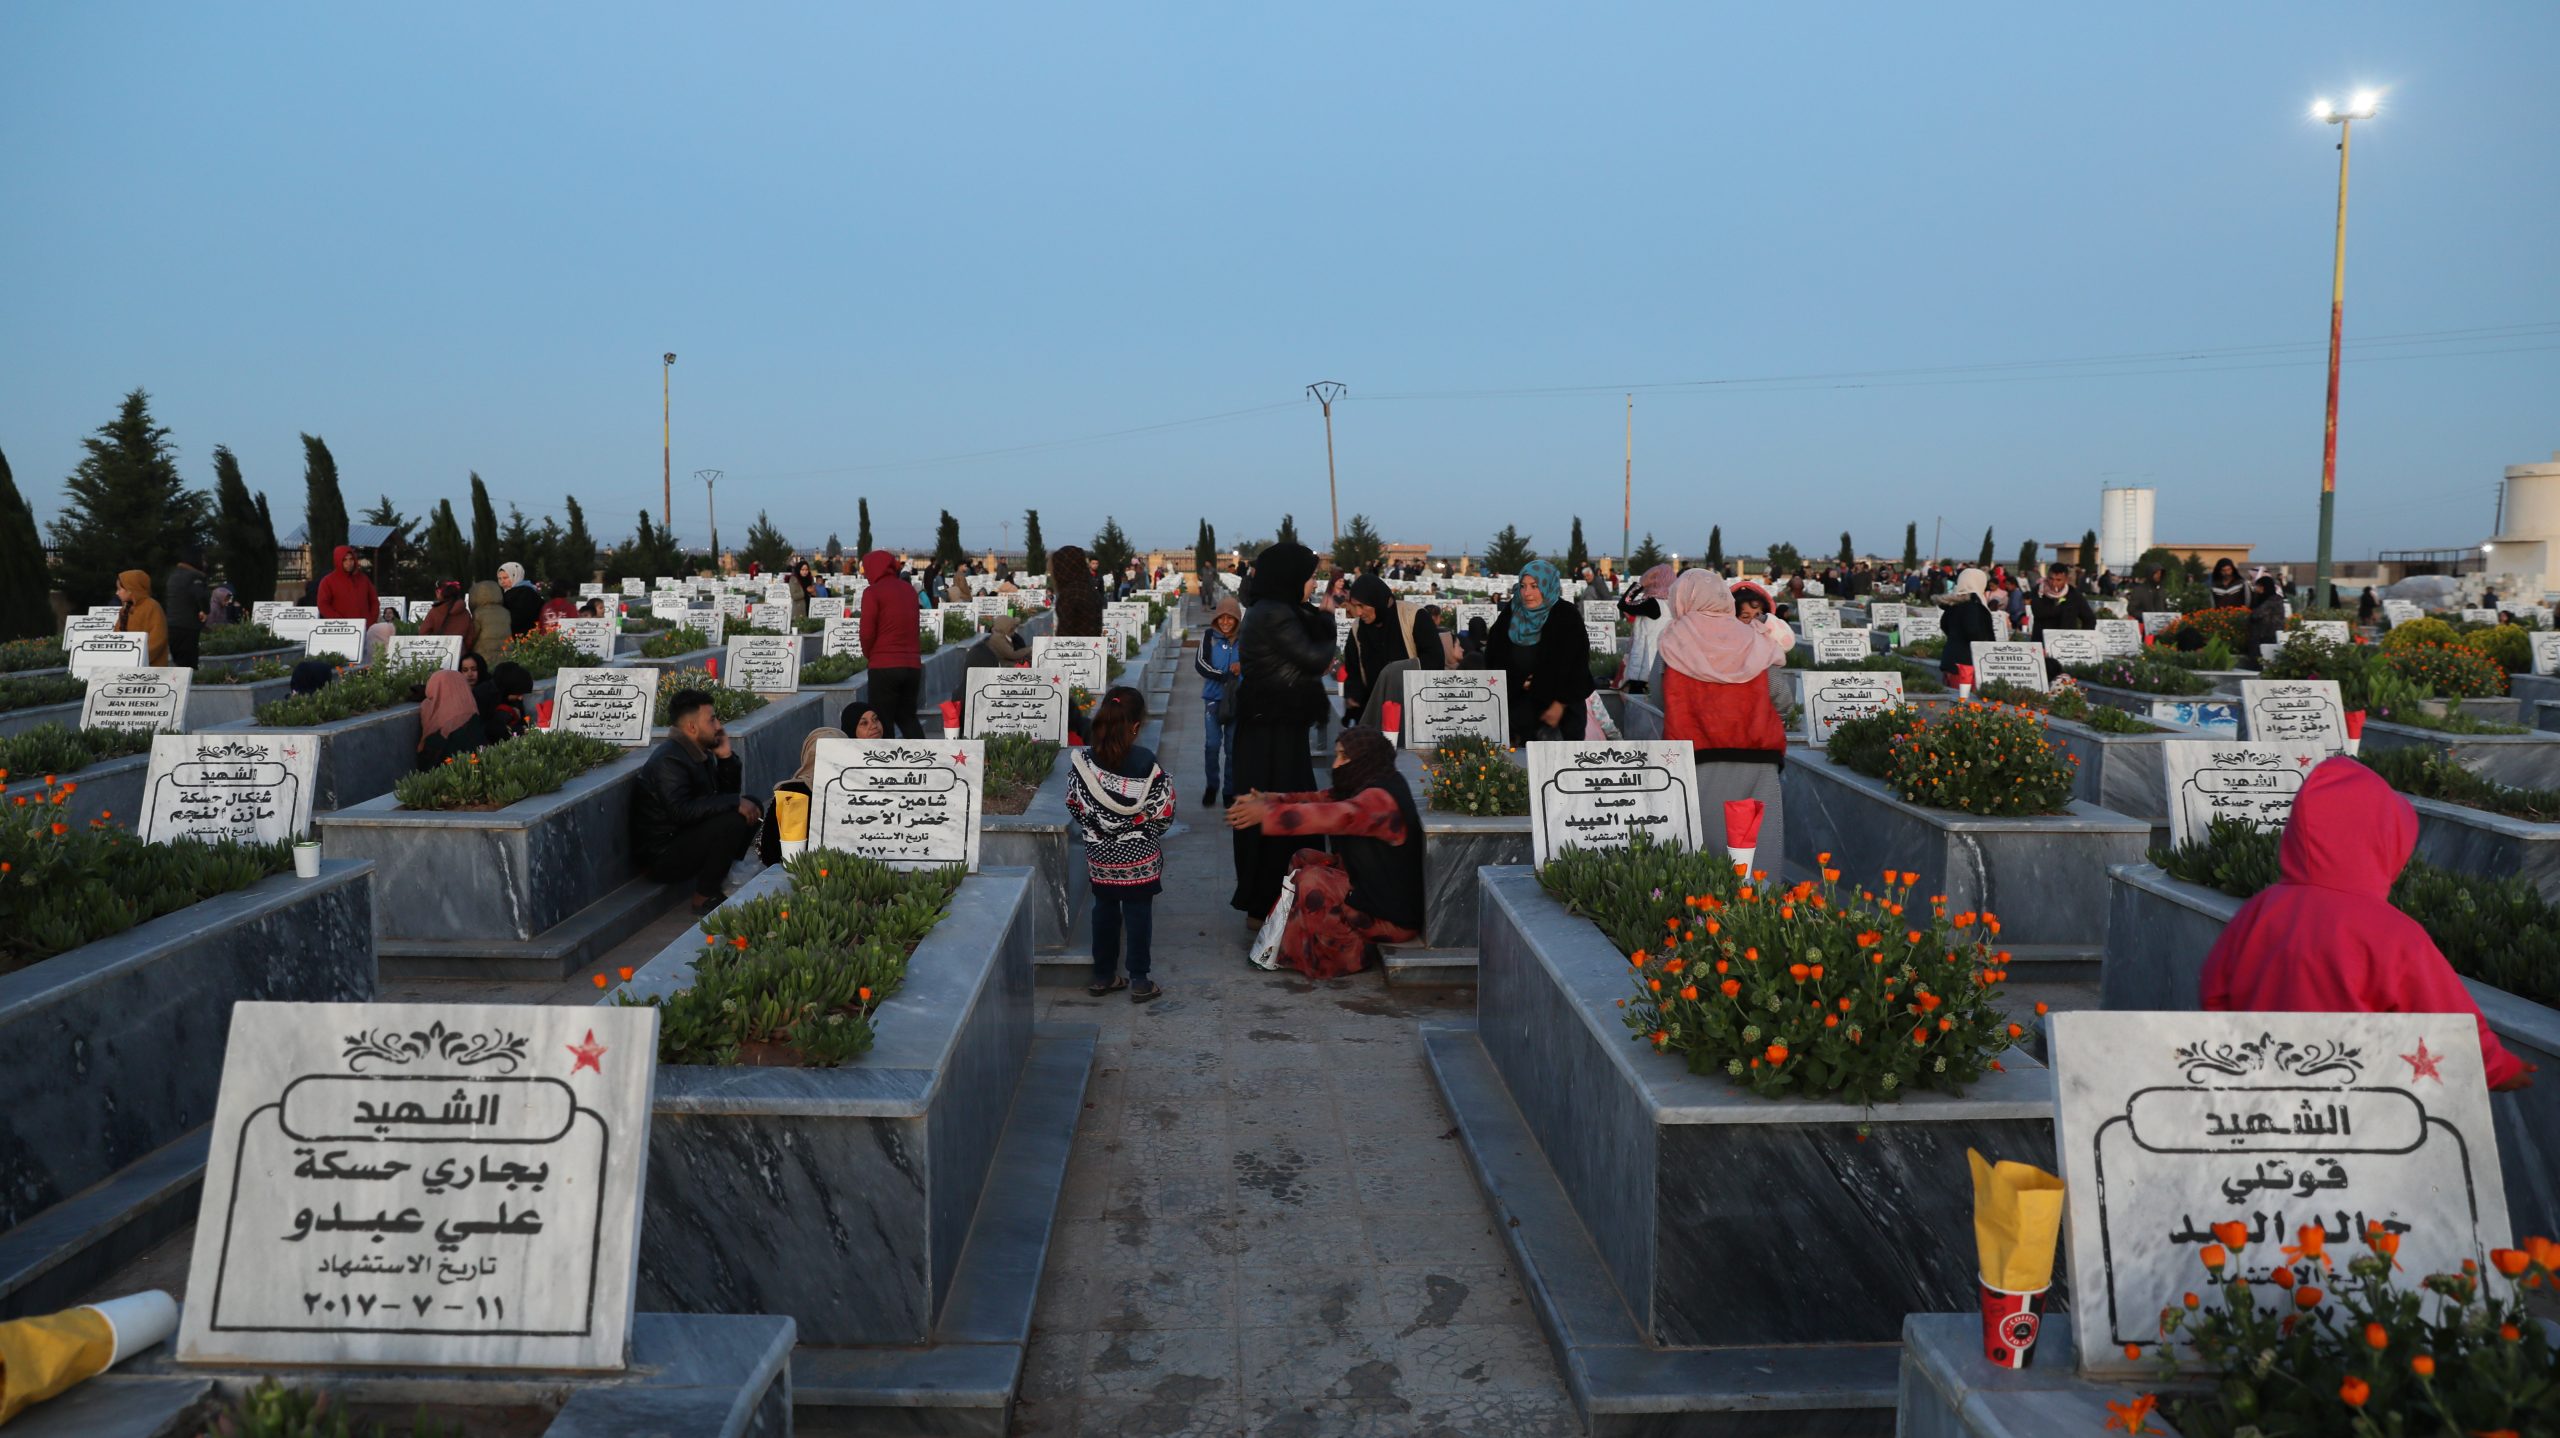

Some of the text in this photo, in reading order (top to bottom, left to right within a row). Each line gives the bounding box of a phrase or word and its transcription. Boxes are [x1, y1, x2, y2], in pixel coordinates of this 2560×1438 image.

[89, 642, 127, 650] ŞEHÎD
[765, 667, 784, 675] توفيق
[1069, 669, 1090, 677] بشار
[117, 685, 156, 695] ŞEHÎD
[587, 687, 621, 697] الشهيد
[1000, 687, 1036, 697] الشهيد
[1438, 689, 1473, 700] الشهيد
[1838, 691, 1872, 700] الشهيد
[573, 700, 633, 710] كيفارا حسكة
[991, 700, 1044, 710] حوت حسكة
[1444, 704, 1468, 713] خضر
[2277, 700, 2310, 710] الشهيد
[566, 711, 598, 720] الظاهر
[986, 710, 1047, 723] بشار علي
[1425, 714, 1487, 724] خضر حسن
[2266, 722, 2330, 733] موفق عواد
[201, 767, 257, 783] الشهيد
[869, 772, 927, 788] الشهيد
[1584, 772, 1642, 790] الشهيد
[2223, 773, 2277, 790] الشهيد
[180, 790, 272, 806] شنكال حسكة
[848, 794, 947, 810] شاهين حسكة
[1594, 797, 1636, 808] محمد
[2209, 795, 2254, 807] حسكة
[170, 806, 275, 823] مازن النجم
[905, 811, 950, 828] خضر
[1565, 813, 1668, 831] محمد العبيد
[232, 827, 255, 837] تاريخ
[1583, 832, 1628, 842] الاستشهاد
[860, 833, 929, 843] تاريخ الاستشهاد
[353, 1088, 500, 1134] الشهيد
[2206, 1099, 2352, 1145] الشهيد
[293, 1147, 550, 1195] بجاري حسكة
[2221, 1157, 2349, 1205] قوتلي
[280, 1201, 543, 1252] علي عبدو
[317, 1254, 497, 1285] تاريخ الاستشهاد
